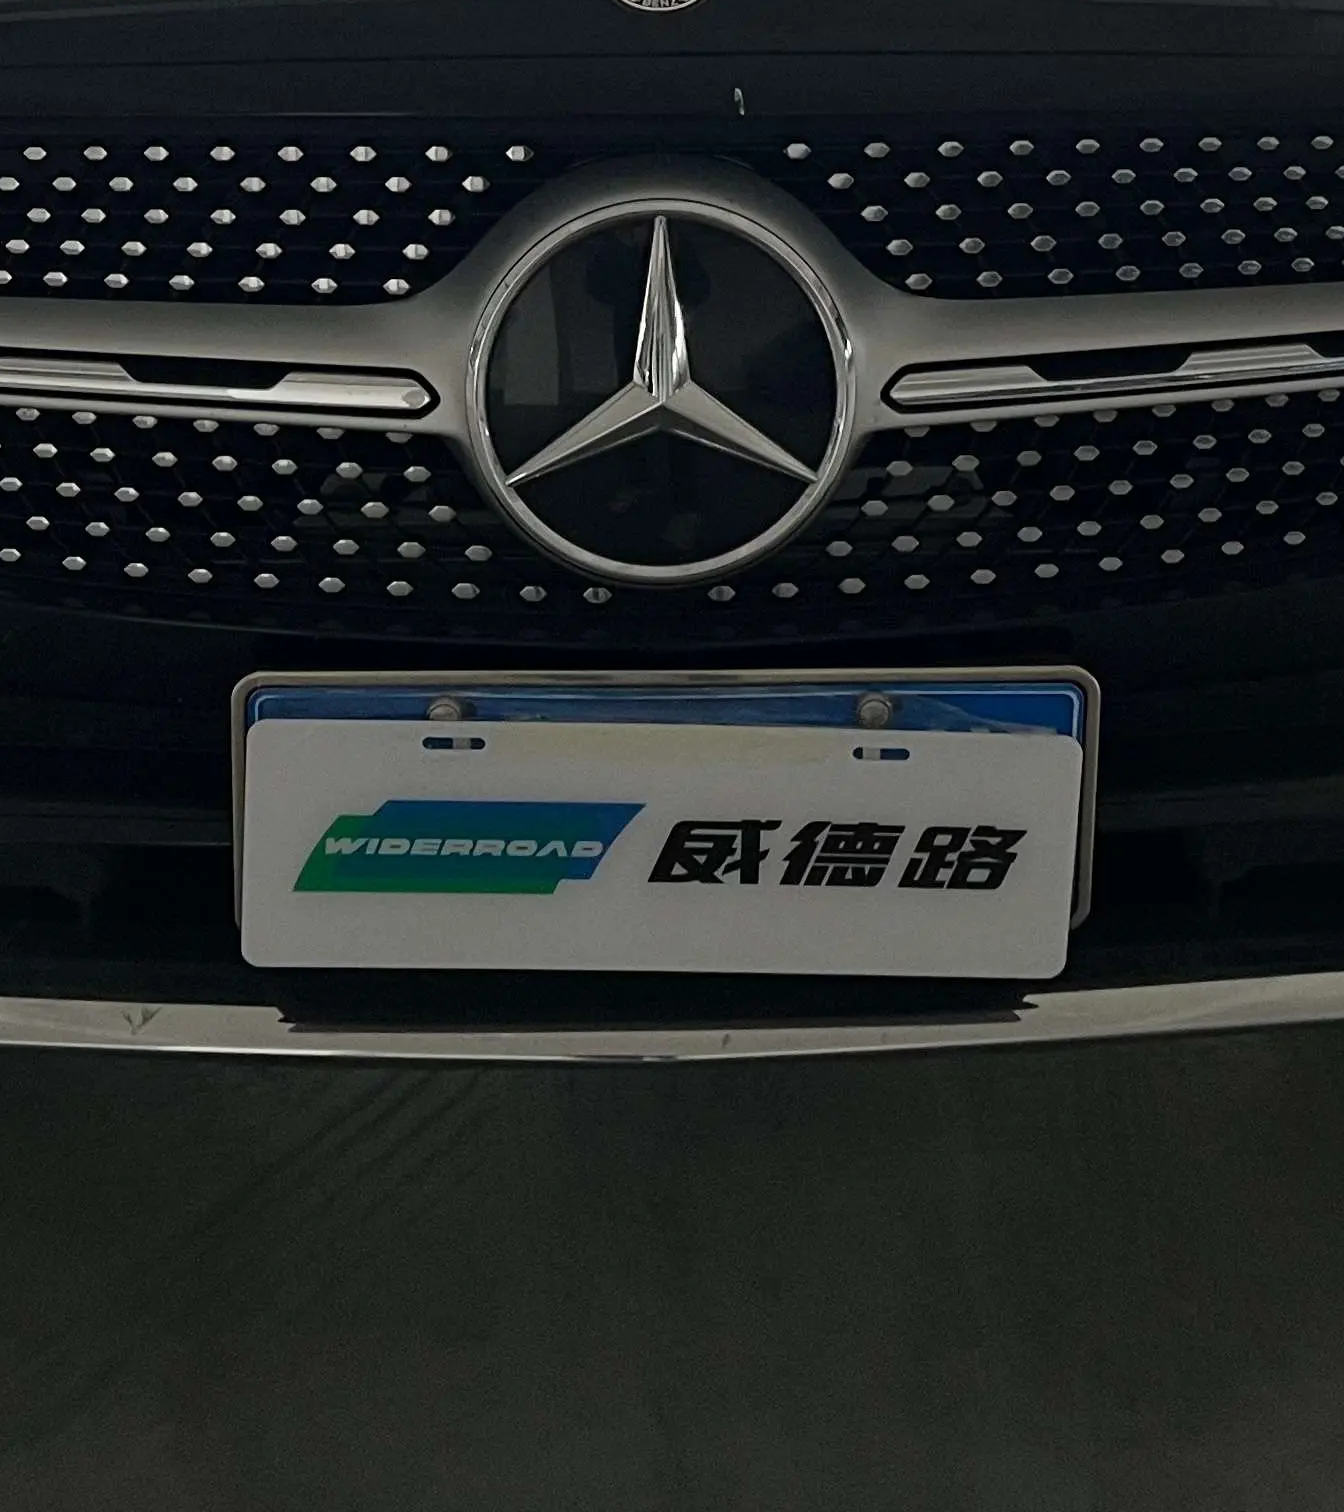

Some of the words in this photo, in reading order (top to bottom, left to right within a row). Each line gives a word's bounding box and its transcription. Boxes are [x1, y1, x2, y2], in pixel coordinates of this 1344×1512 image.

[324, 837, 605, 858] WIDERROAD
[647, 819, 1028, 890] 威德路
